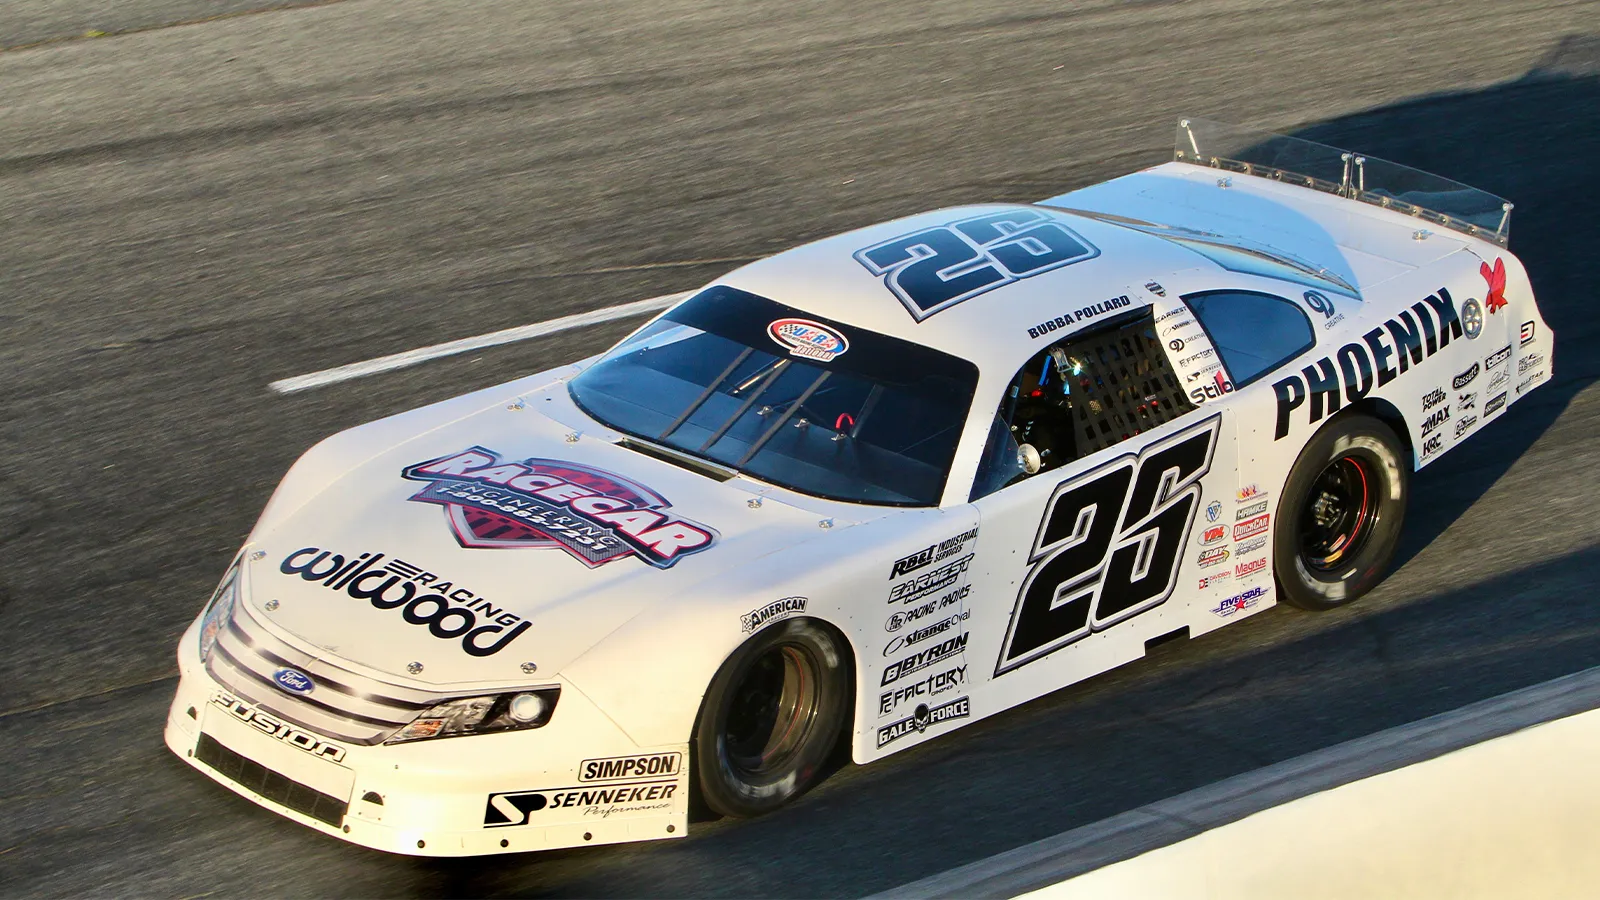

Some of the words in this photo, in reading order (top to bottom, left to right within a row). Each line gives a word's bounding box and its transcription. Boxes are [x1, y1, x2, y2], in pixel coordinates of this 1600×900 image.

[1027, 314, 1075, 339] BUBBA
[1074, 295, 1131, 321] POLLARD
[1155, 306, 1187, 323] EARNEST
[1272, 287, 1463, 442] PHOENIX
[1190, 370, 1233, 403] Stilo
[1422, 387, 1443, 405] TOTAL
[1423, 392, 1447, 413] POWER
[1422, 432, 1442, 456] KRC
[418, 450, 711, 559] RACECAR
[450, 482, 620, 547] ENGINEERING
[1237, 502, 1267, 519] HAMKE
[934, 544, 963, 563] SERVICES
[937, 527, 979, 553] INDUSTRIAL
[888, 553, 975, 604] EARNEST
[1236, 557, 1267, 575] Magnus
[279, 547, 533, 658] wilwood
[412, 571, 521, 627] RACING
[751, 599, 806, 630] AMERICAN
[904, 600, 938, 624] RACING
[939, 584, 971, 609] RADIOS
[1219, 595, 1240, 611] FIVE
[1241, 587, 1261, 601] STAR
[904, 618, 952, 648] Strange
[951, 608, 971, 626] Oval
[901, 631, 969, 673] BYRON
[279, 670, 308, 689] Ford
[894, 664, 968, 708] FACTORY
[210, 689, 347, 763] FUSION
[879, 719, 914, 745] GALE
[930, 700, 969, 723] FORCE
[584, 755, 676, 780] SIMPSON
[549, 784, 678, 809] SENNEKER
[583, 802, 671, 819] Performance
